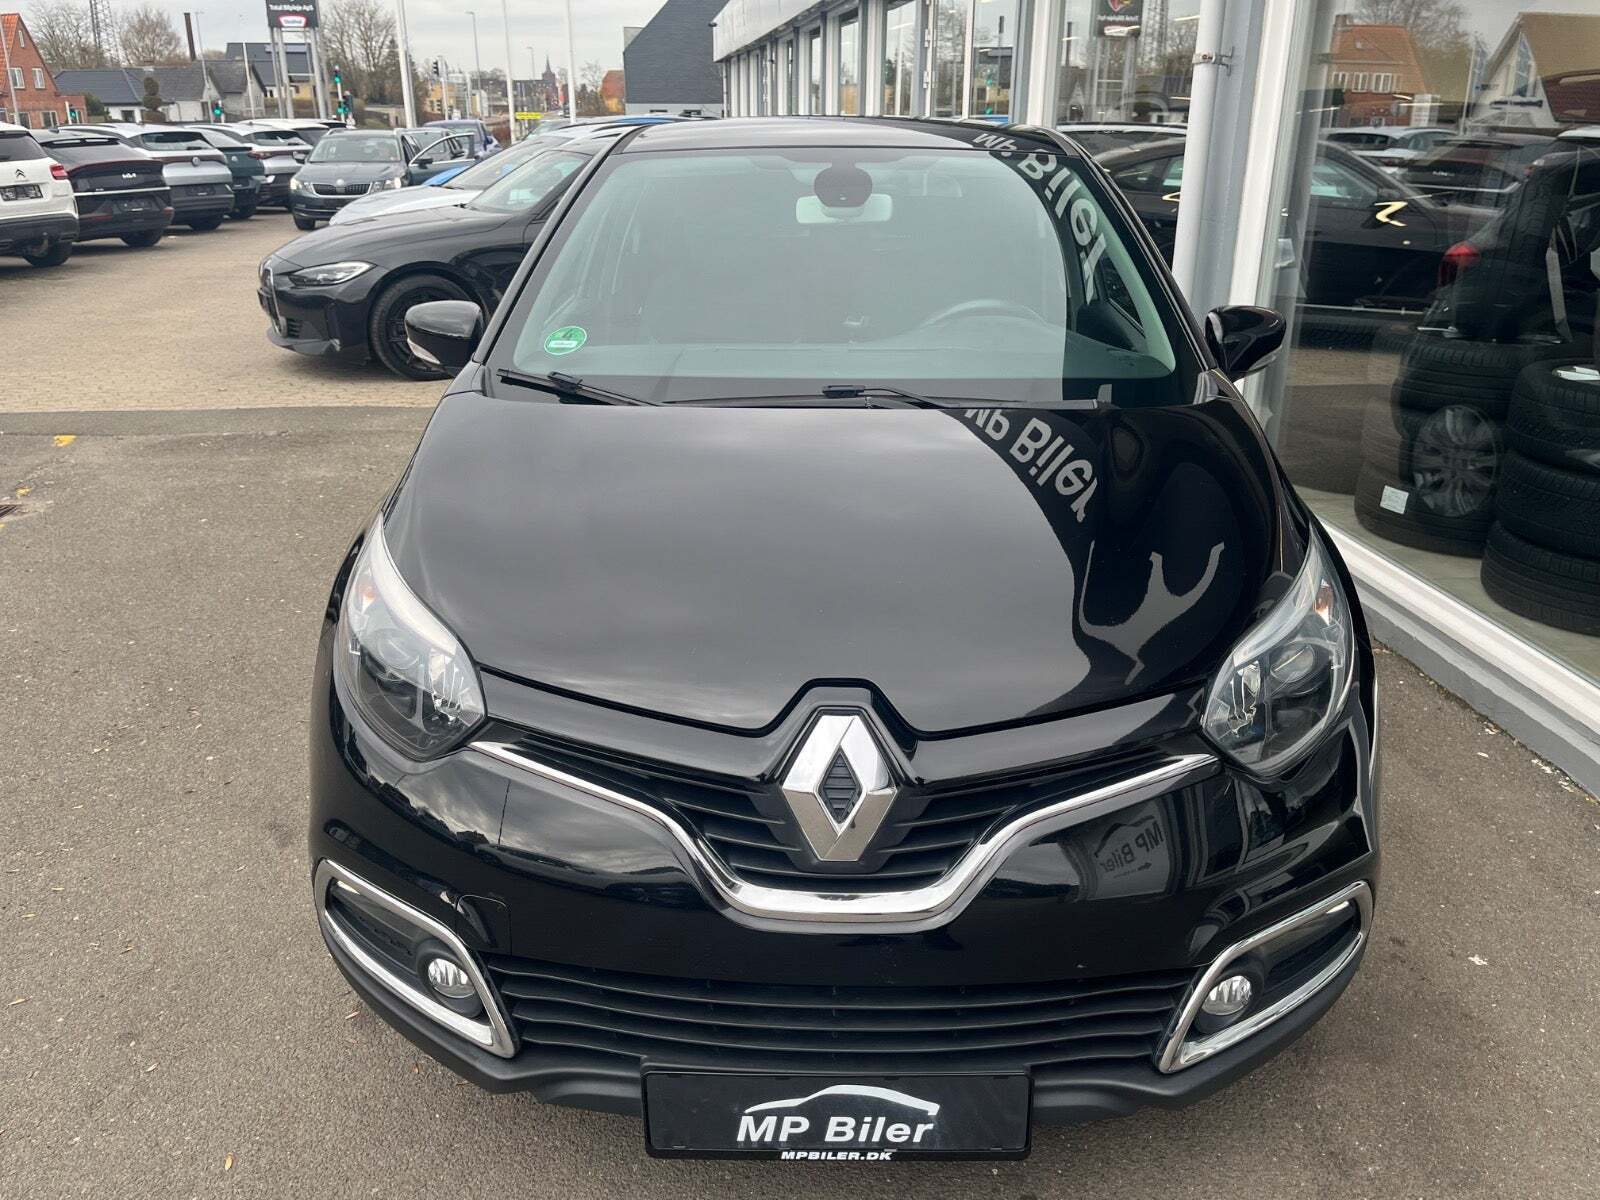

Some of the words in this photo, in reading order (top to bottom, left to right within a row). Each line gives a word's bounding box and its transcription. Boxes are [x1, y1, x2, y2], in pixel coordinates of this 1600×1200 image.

[736, 1115, 810, 1143] MP
[824, 1115, 934, 1143] Biler
[780, 1150, 893, 1162] MPBILER.DK
